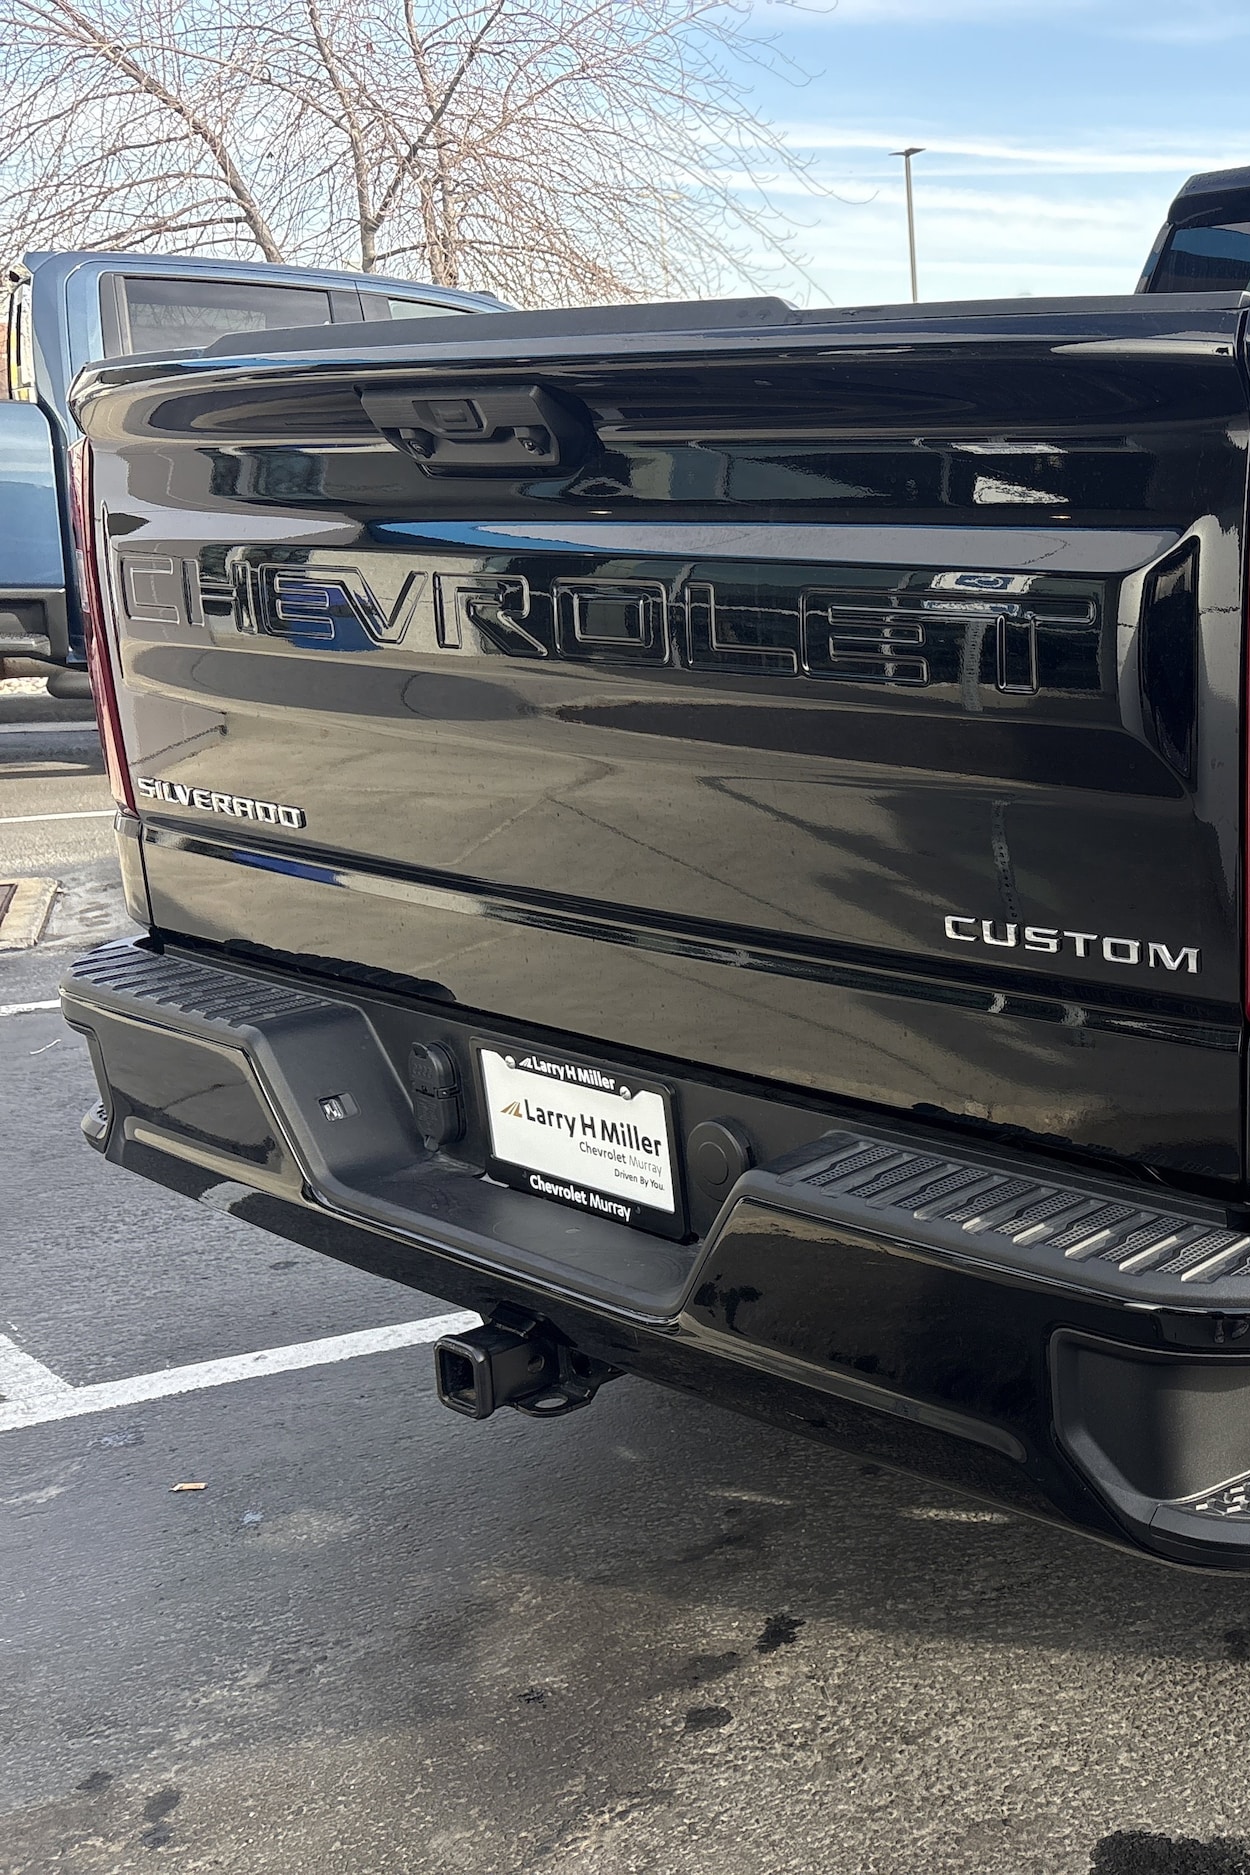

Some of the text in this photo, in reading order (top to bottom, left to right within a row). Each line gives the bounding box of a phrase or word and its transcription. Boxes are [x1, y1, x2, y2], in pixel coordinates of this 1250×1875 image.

[120, 554, 1097, 696] CHEVROLET
[137, 776, 307, 828] SILVERADO
[944, 914, 1200, 974] CUSTOM
[532, 1056, 616, 1091] Larry H Miller
[524, 1098, 662, 1157] Larry H Miller
[579, 1141, 663, 1177] Chevrolet Murray
[614, 1168, 638, 1183] Driven
[639, 1175, 649, 1187] By
[529, 1174, 632, 1222] Chevrolet Murray
